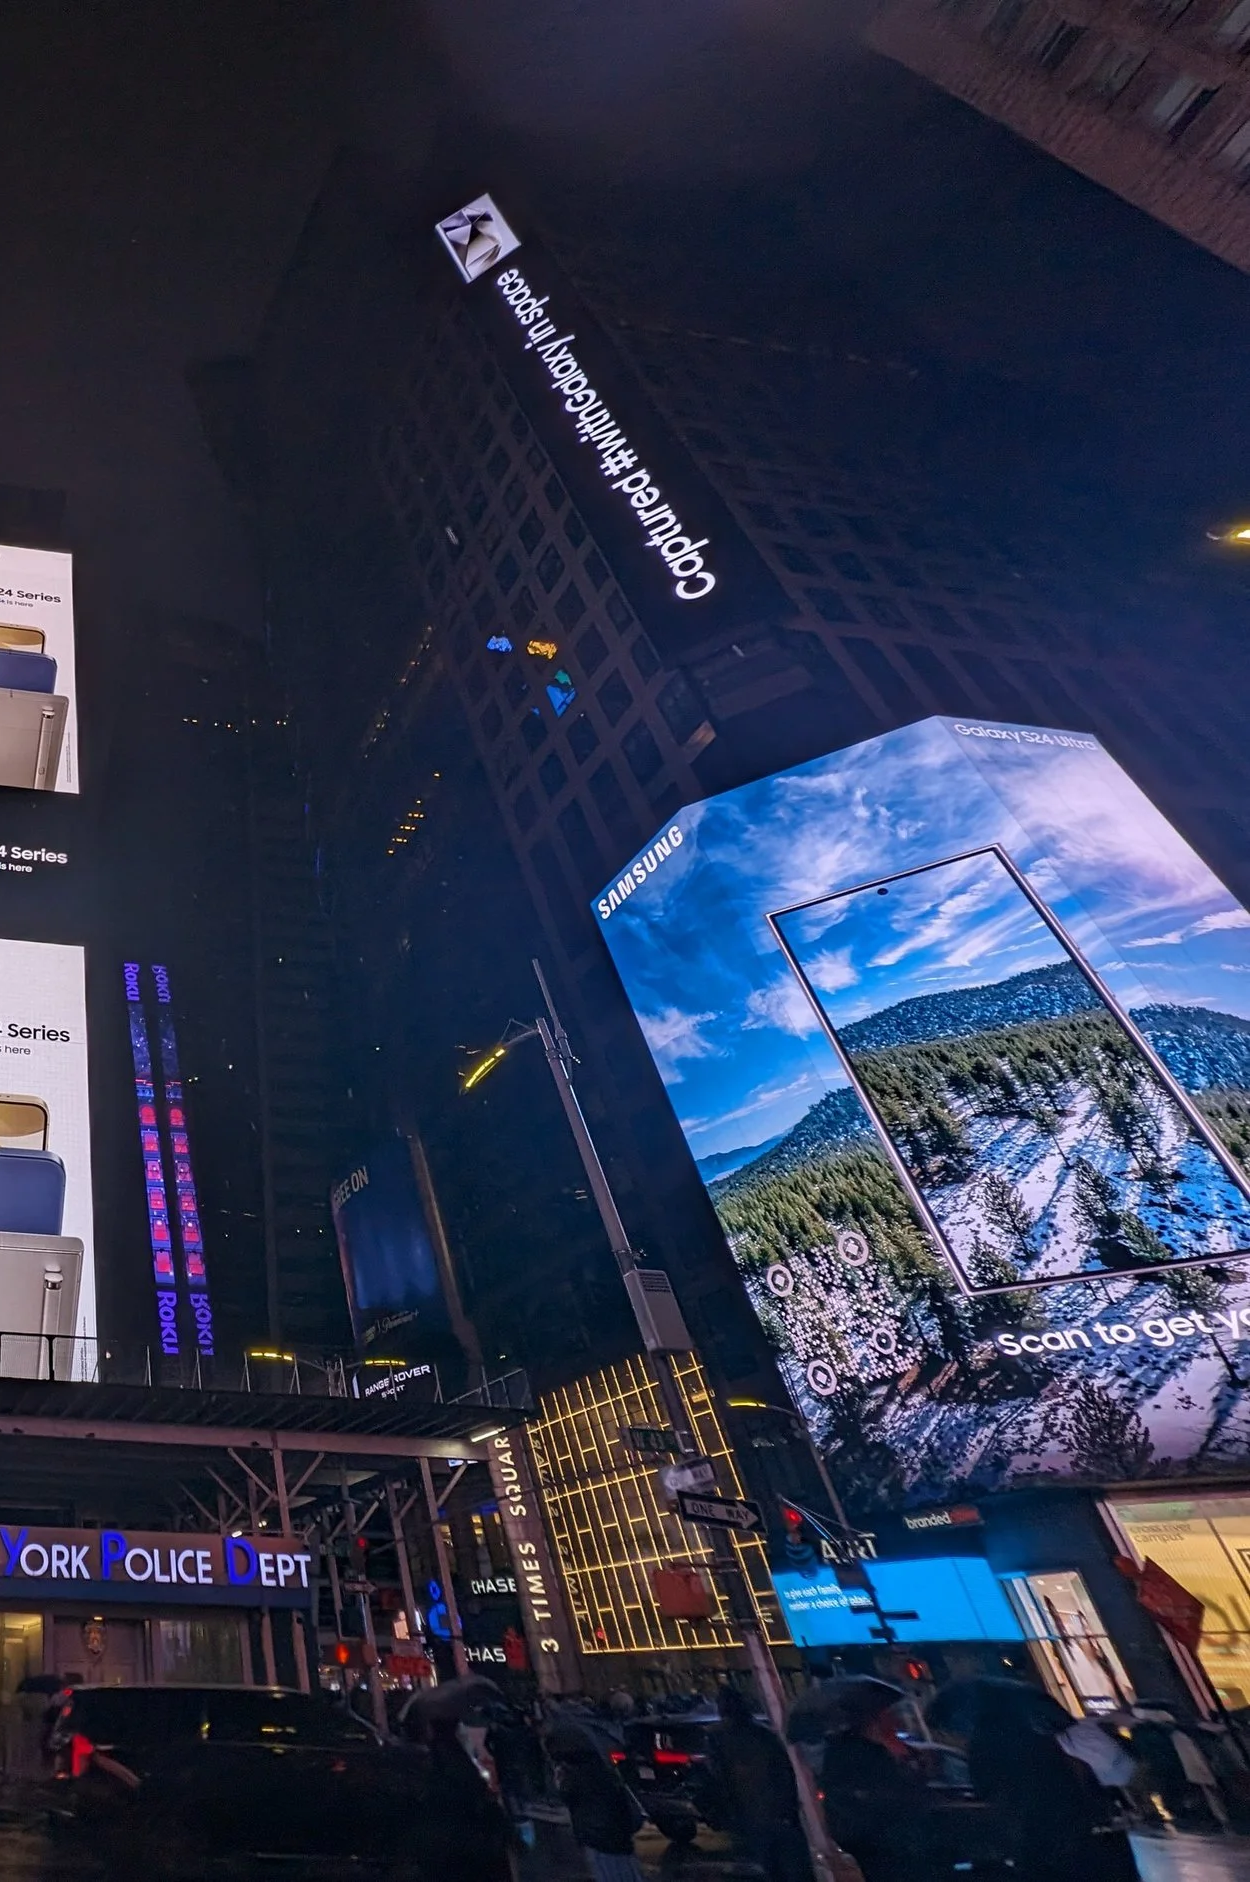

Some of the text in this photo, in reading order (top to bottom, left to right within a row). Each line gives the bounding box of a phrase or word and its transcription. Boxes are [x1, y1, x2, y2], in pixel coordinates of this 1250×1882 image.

[497, 268, 716, 600] Captured #withGalaxy in space
[14, 600, 34, 608] here
[16, 590, 62, 603] Series
[953, 723, 1099, 750] Galaxy S24 Ultra
[10, 846, 68, 864] Series
[8, 862, 33, 873] here
[597, 825, 684, 920] SAMSUNG
[7, 1023, 70, 1042] Series
[4, 1044, 31, 1055] here
[997, 1328, 1093, 1356] Scan
[1092, 1321, 1136, 1345] to
[1141, 1310, 1213, 1347] get
[364, 1377, 390, 1397] RANGE
[691, 1502, 714, 1518] ONE
[495, 1436, 560, 1654] 3 TIMES SQUAR
